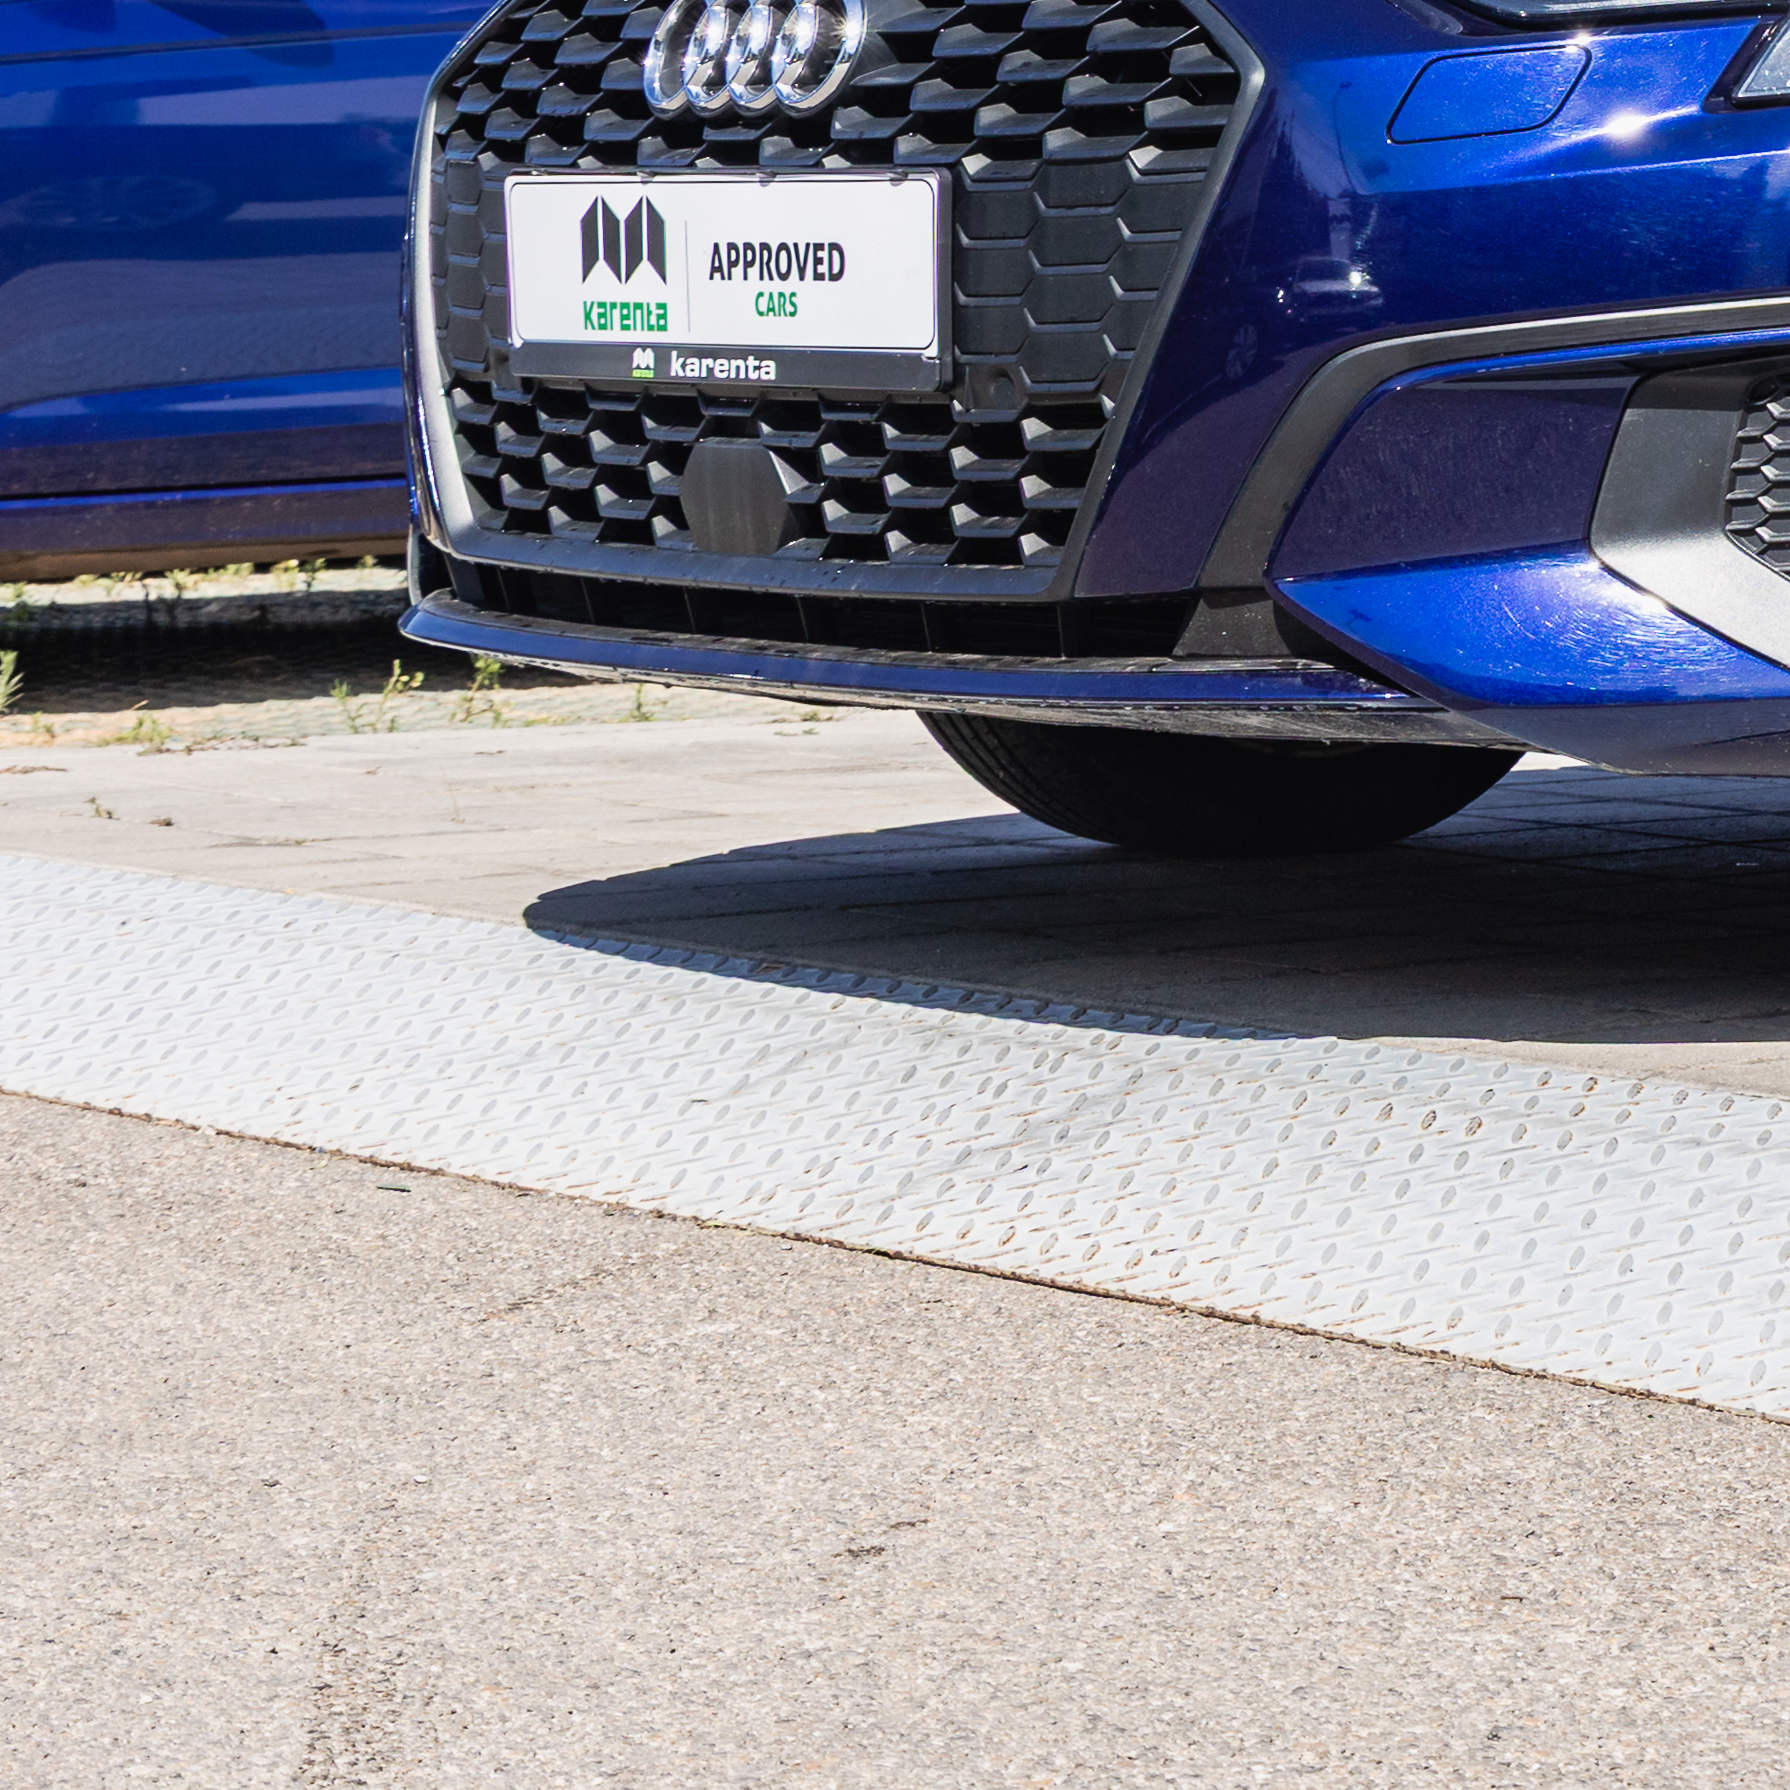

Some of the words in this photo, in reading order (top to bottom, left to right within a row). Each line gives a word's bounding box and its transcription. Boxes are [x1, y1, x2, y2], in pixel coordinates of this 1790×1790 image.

[709, 242, 846, 282] APPROVED
[755, 291, 798, 317] CARS
[670, 350, 776, 381] karenta
